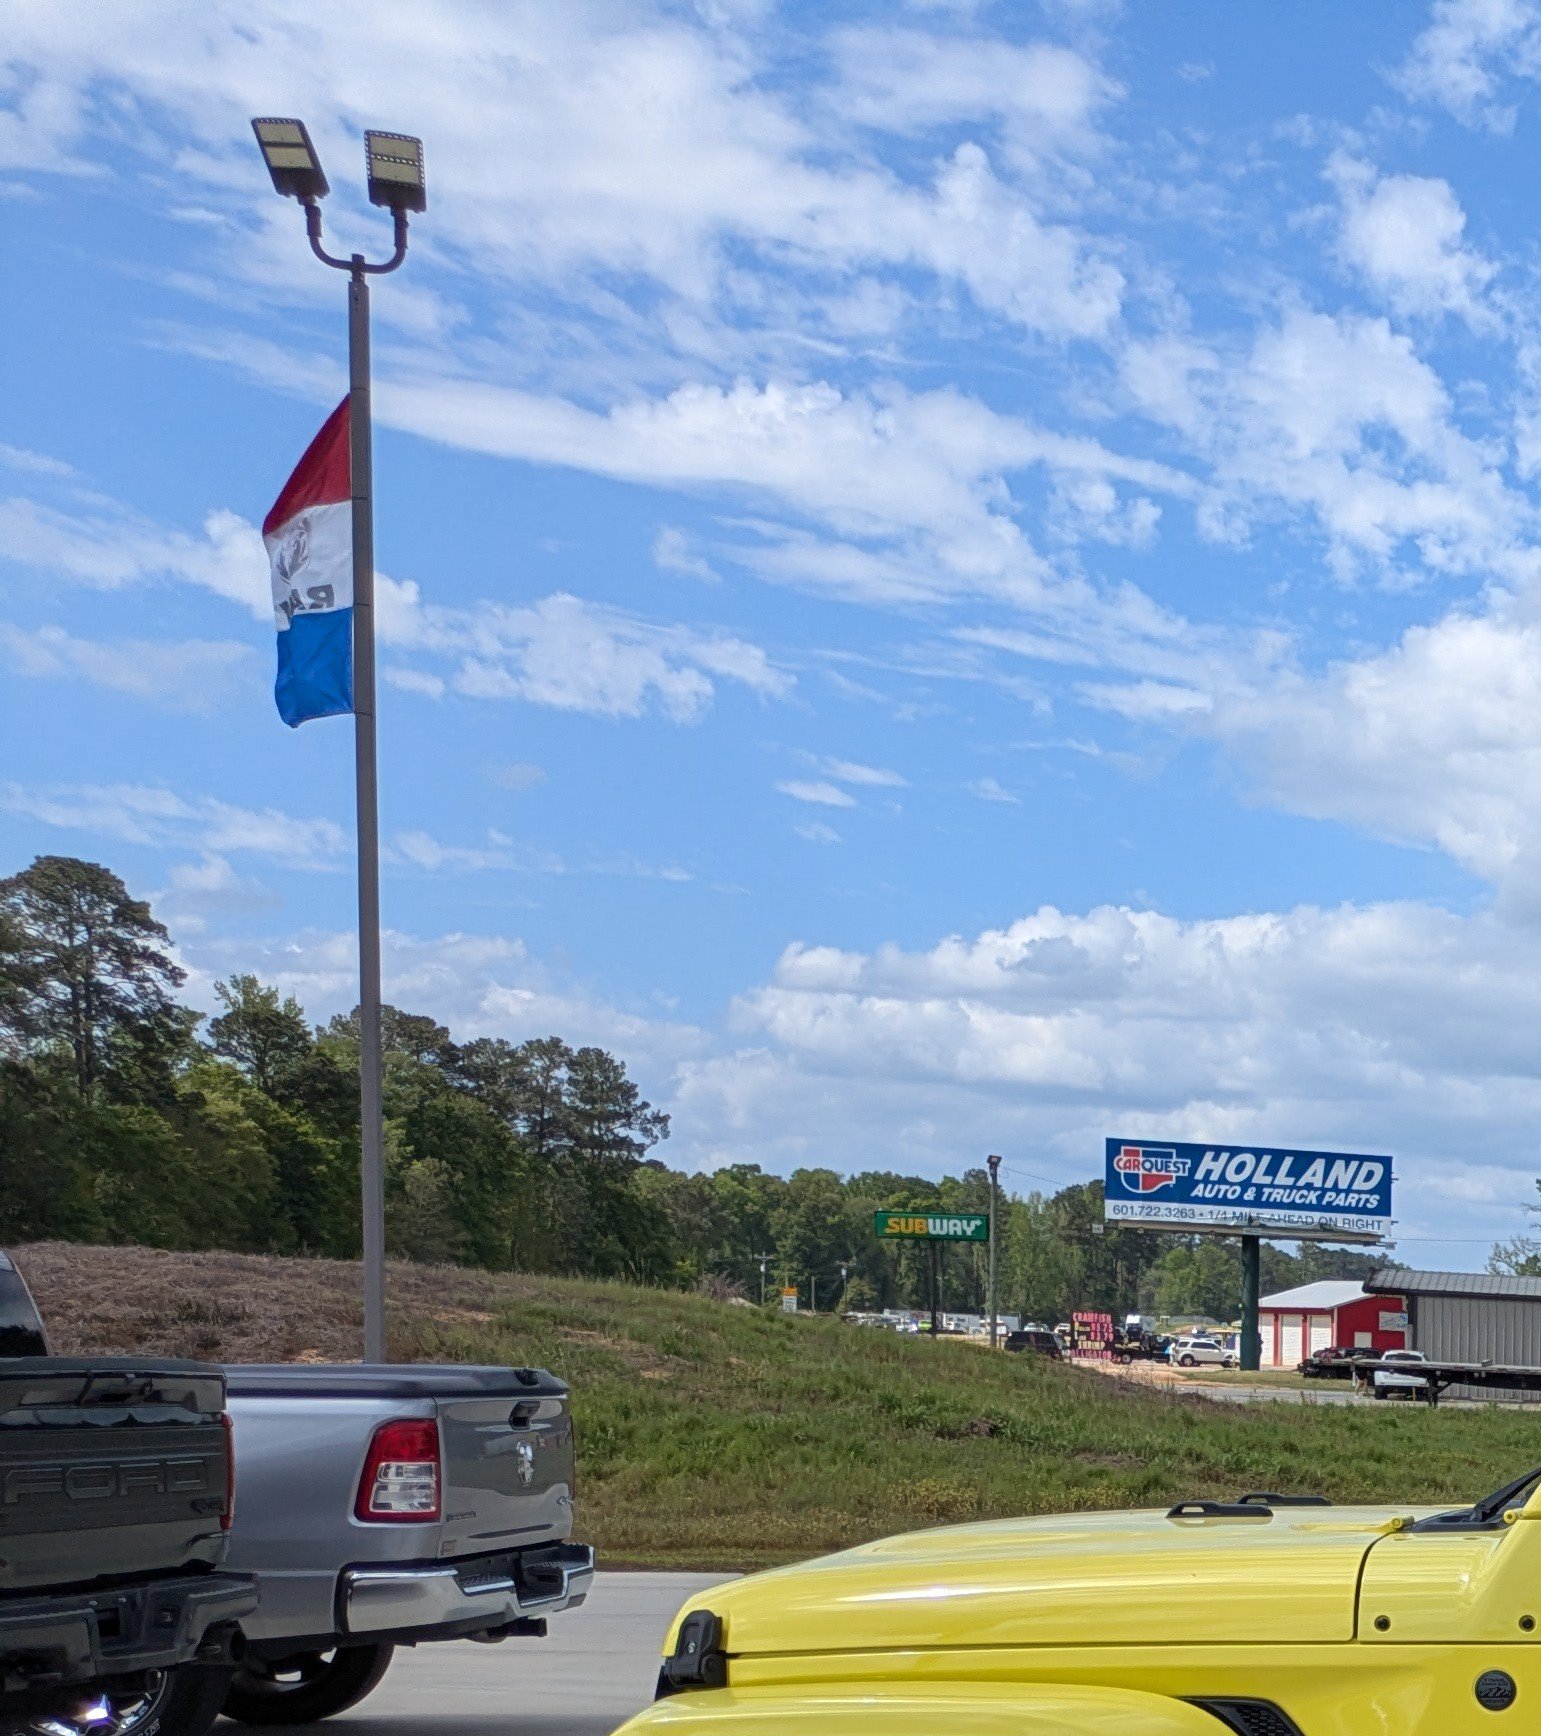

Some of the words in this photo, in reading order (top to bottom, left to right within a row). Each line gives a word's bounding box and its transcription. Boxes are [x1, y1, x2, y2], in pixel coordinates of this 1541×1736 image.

[1115, 1157, 1189, 1174] CARQUEST
[1194, 1150, 1385, 1191] HOLLAND
[1190, 1183, 1243, 1201] AUTO
[1243, 1186, 1257, 1202] &
[1260, 1187, 1319, 1206] TRUCK
[1321, 1191, 1381, 1210] PARTS
[884, 1217, 983, 1236] SUBWAY
[1112, 1204, 1197, 1219] 601.722.3263
[1342, 1217, 1384, 1231] RIGHT
[2, 1459, 209, 1503] FORD
